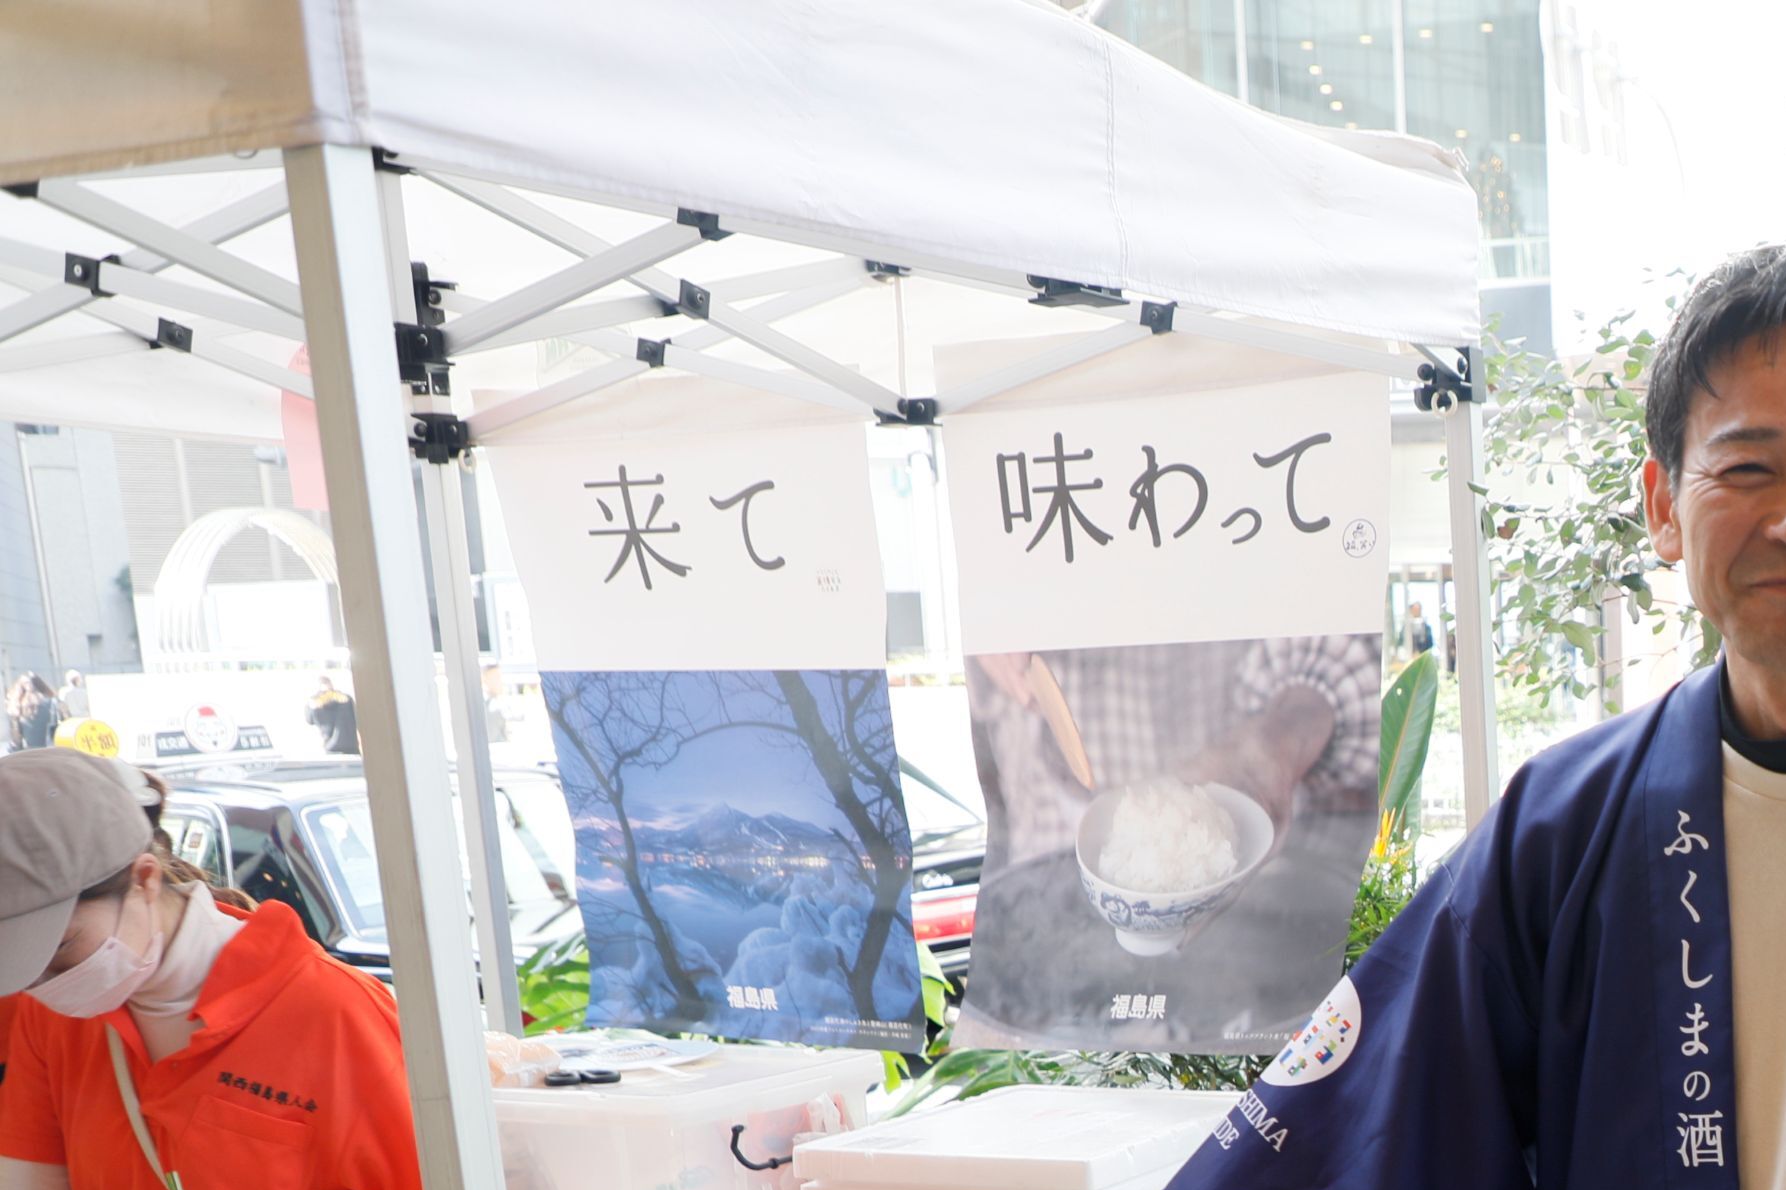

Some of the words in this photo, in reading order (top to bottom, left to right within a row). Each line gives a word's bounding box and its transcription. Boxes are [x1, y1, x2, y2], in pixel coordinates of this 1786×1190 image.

[584, 464, 785, 590] 来て
[996, 432, 1332, 563] 味わって
[726, 985, 778, 1011] 福島県
[1110, 994, 1167, 1020] 福島県
[1663, 809, 1725, 1168] ふくしまの酒
